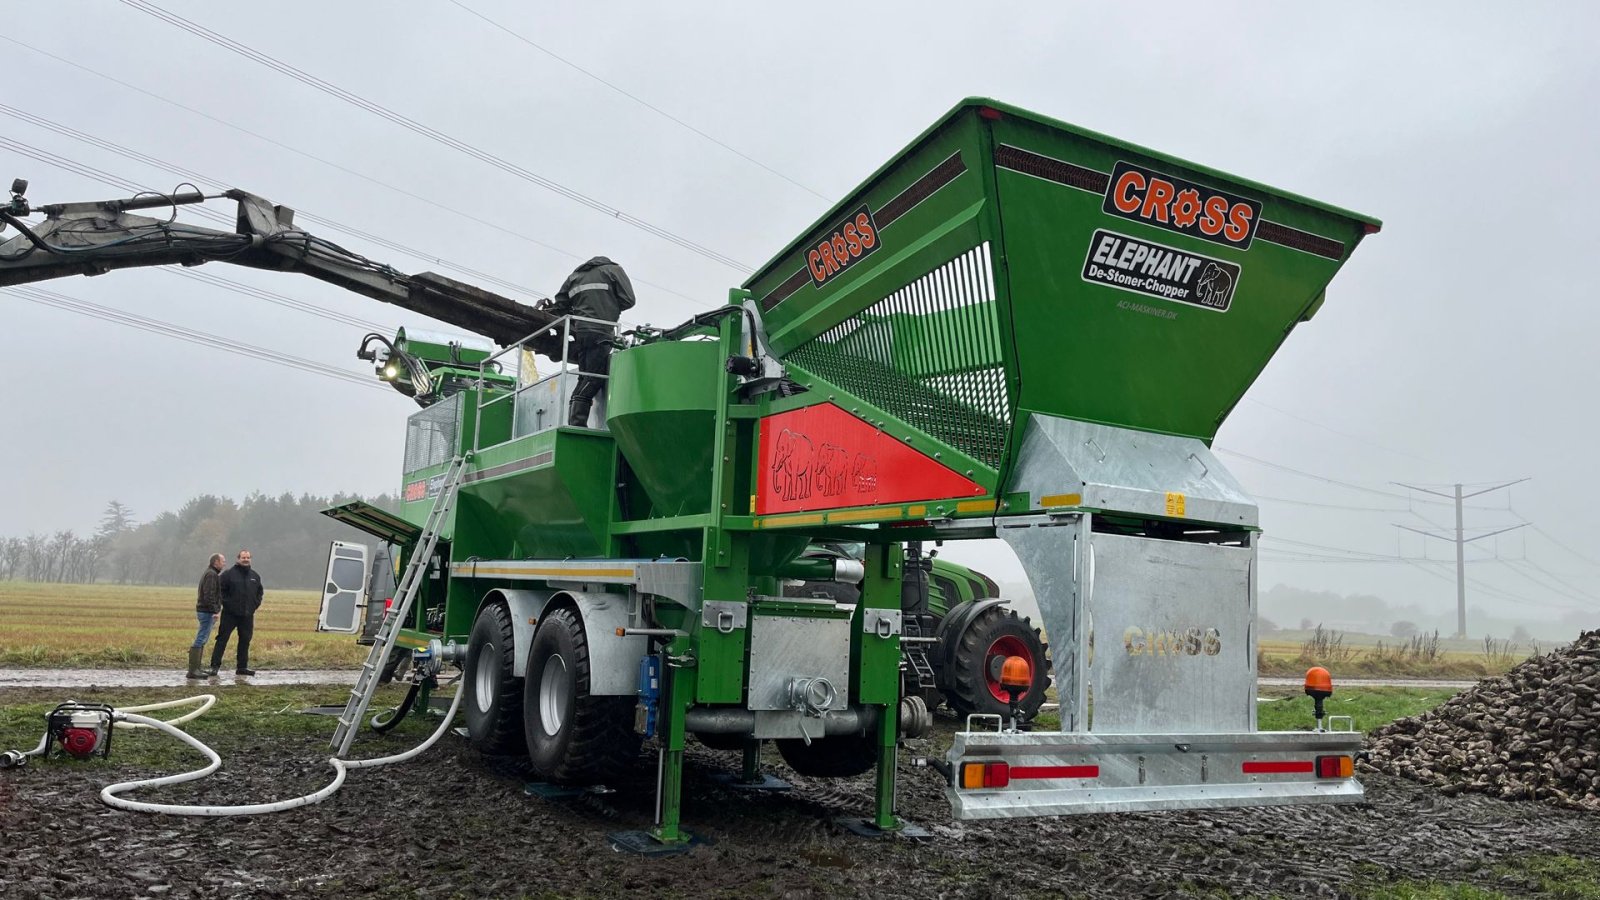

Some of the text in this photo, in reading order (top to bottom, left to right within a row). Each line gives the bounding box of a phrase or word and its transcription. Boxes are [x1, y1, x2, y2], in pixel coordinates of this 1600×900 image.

[1114, 171, 1253, 241] CROSS
[809, 213, 875, 281] CROSS
[1092, 236, 1201, 283] ELEPHANT
[1088, 265, 1190, 299] De-Stoner-Chopper
